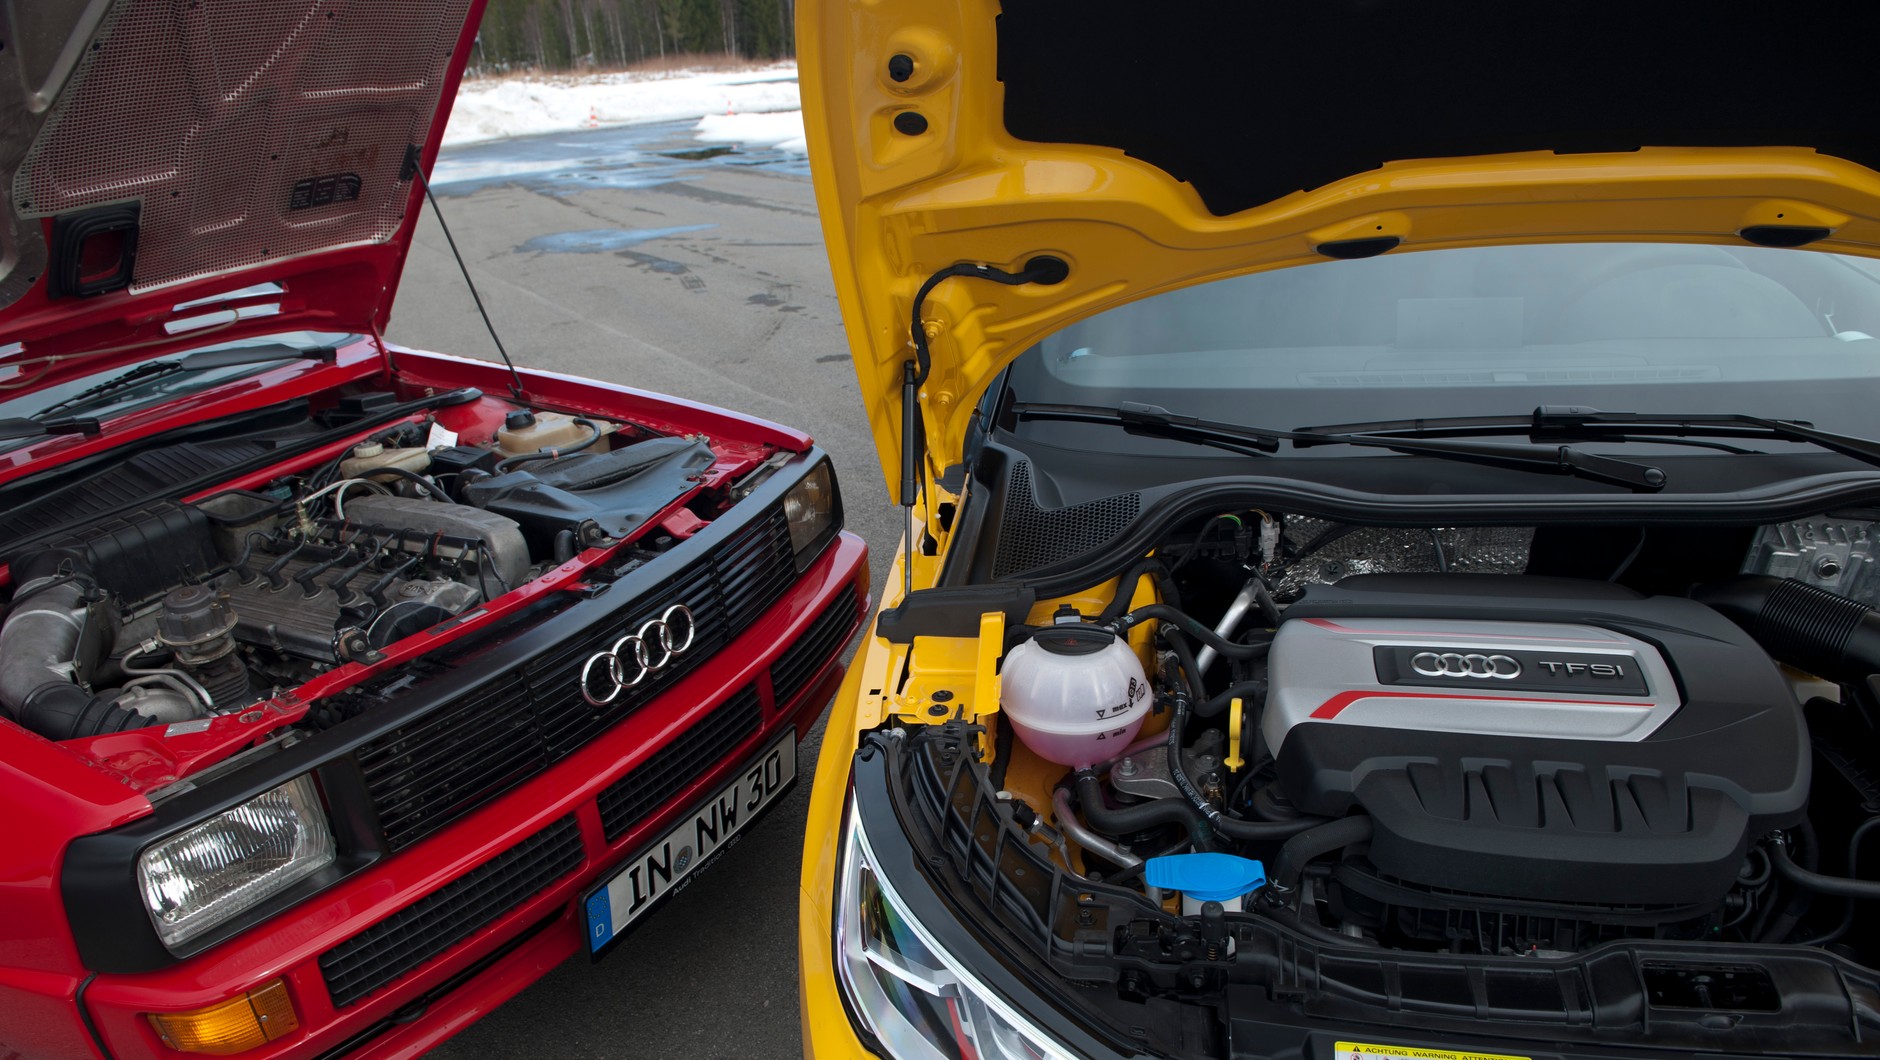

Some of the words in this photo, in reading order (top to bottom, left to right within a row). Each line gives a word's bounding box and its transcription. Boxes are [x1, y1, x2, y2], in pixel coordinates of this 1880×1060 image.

[1539, 662, 1624, 678] TFSI
[1112, 703, 1128, 712] max
[1112, 728, 1126, 737] min
[628, 842, 672, 915] IN
[696, 786, 739, 857] NW
[745, 749, 781, 812] 30
[672, 877, 692, 897] Audi
[692, 850, 725, 878] Tradition
[595, 923, 605, 938] D
[1365, 1047, 1408, 1056] ACHTUNG
[1412, 1051, 1457, 1060] WARNING
